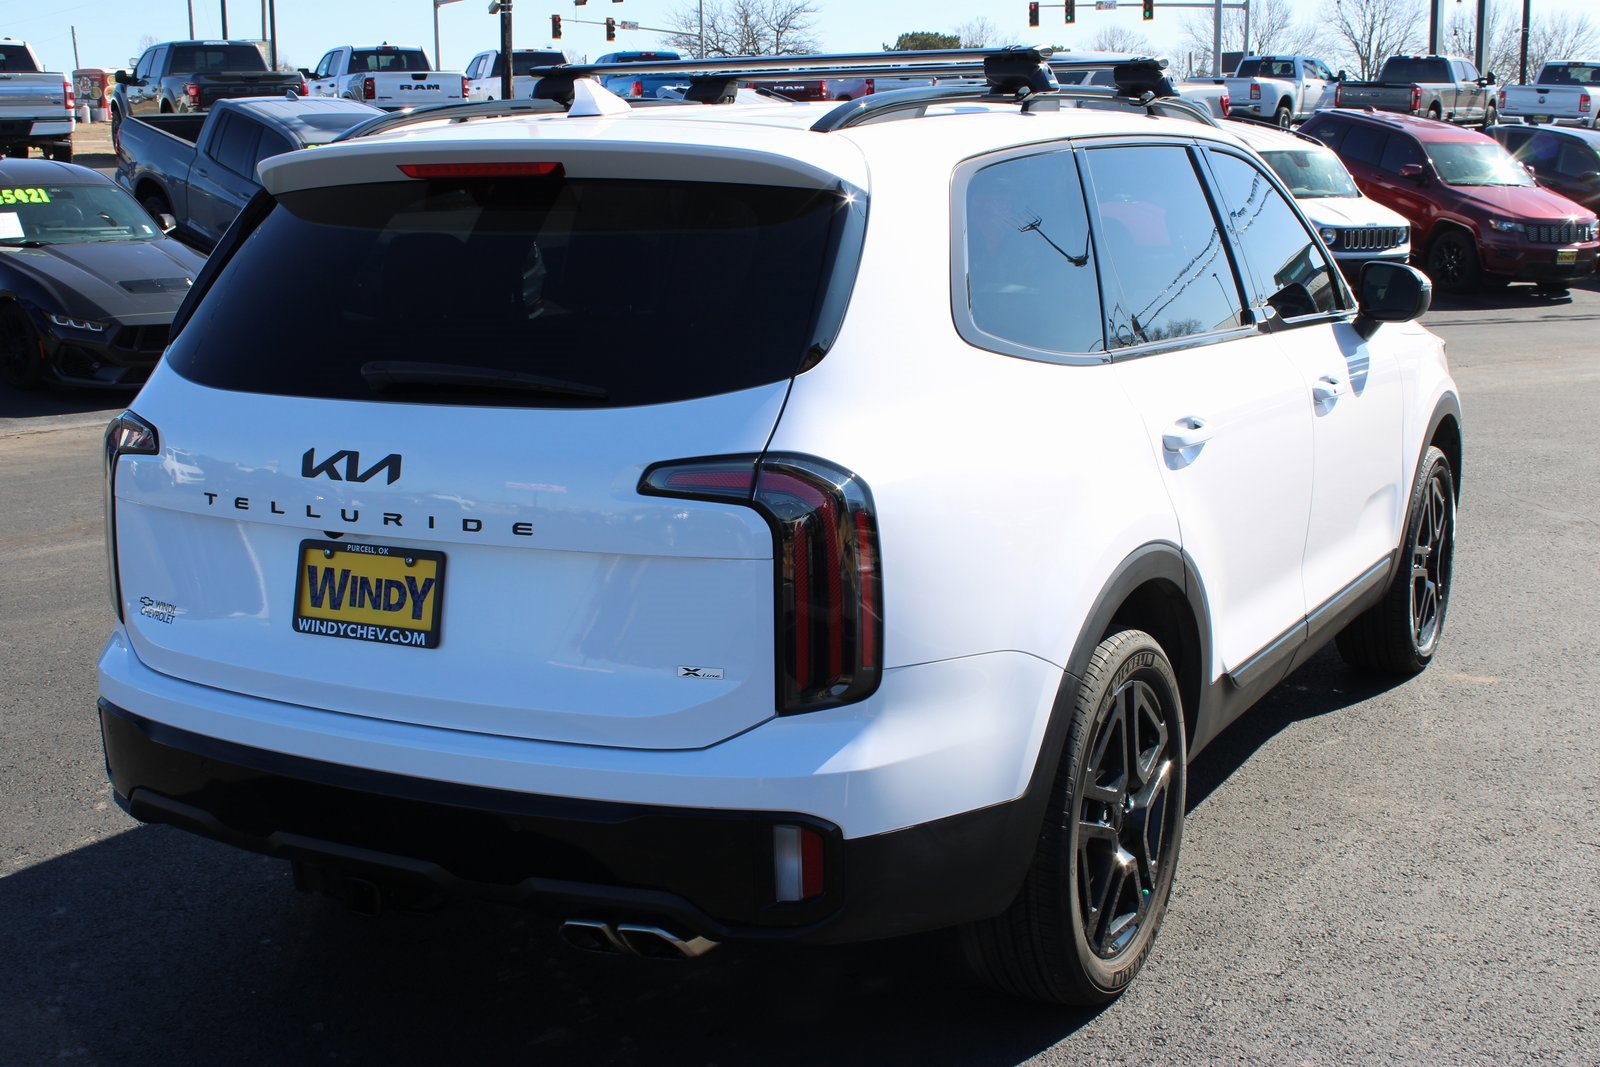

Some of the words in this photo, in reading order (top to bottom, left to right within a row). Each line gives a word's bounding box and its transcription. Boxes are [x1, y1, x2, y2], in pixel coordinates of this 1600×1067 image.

[301, 447, 402, 485] KIA
[203, 492, 534, 537] TELLURIDE
[347, 544, 377, 554] PURCELL,
[378, 547, 389, 555] OK
[140, 605, 176, 625] CHEVROLET
[155, 600, 177, 614] WINDY
[298, 617, 426, 646] WINDYCHEV.COM
